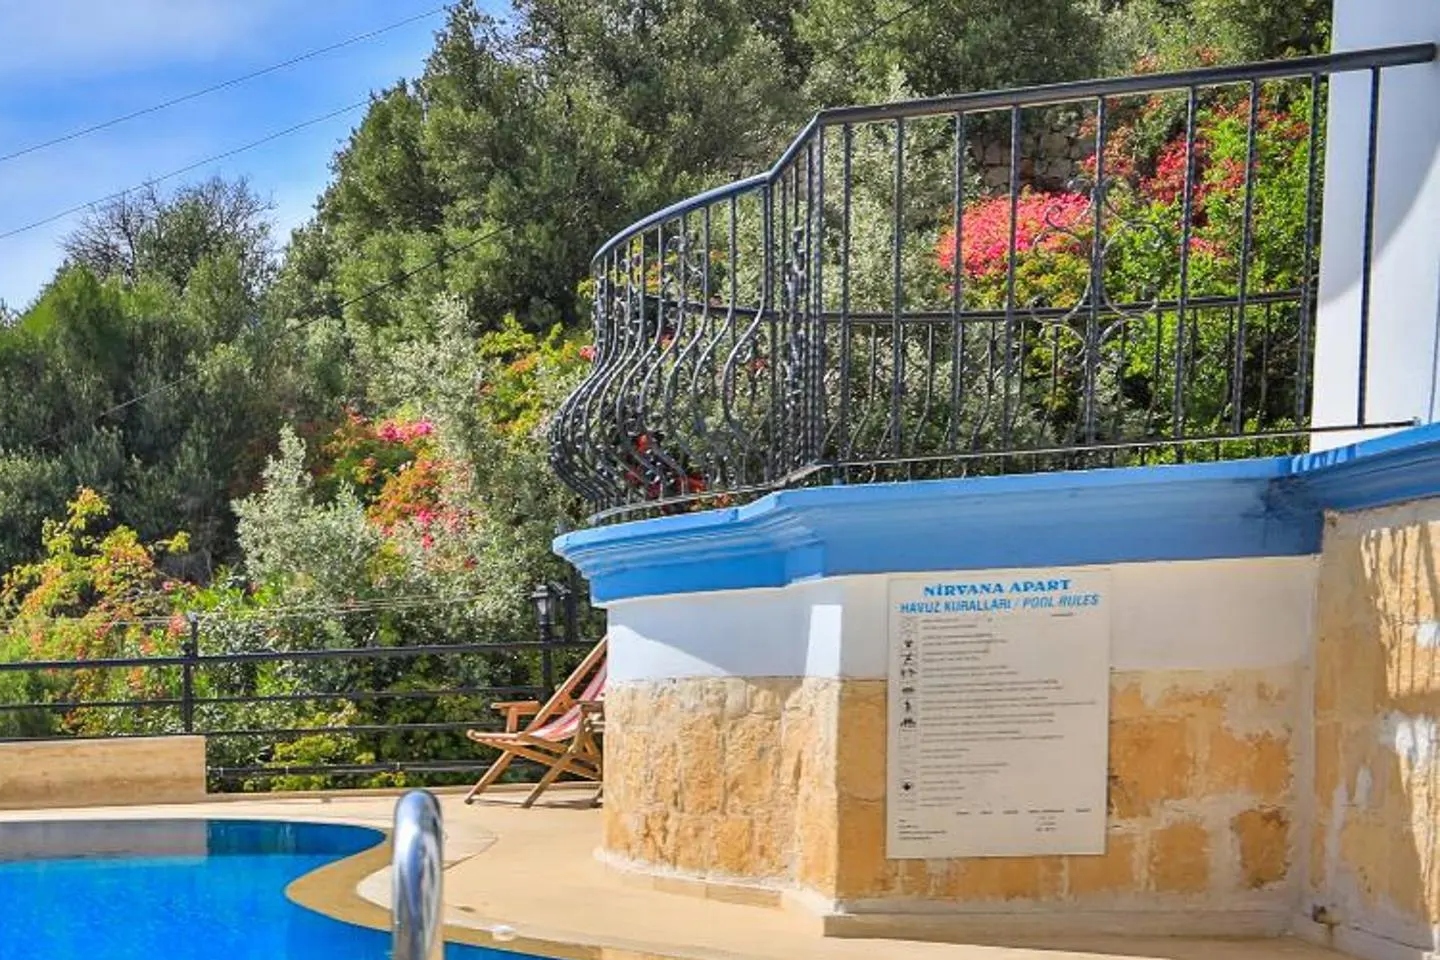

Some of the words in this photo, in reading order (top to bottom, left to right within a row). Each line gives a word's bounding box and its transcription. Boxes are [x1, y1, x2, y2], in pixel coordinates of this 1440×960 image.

[923, 582, 1005, 597] NİRVANA
[1010, 578, 1072, 593] APART
[900, 601, 942, 614] HAVUZ
[944, 597, 1011, 612] KURALLARI
[1023, 596, 1054, 609] POOL
[1059, 593, 1099, 607] RULES
